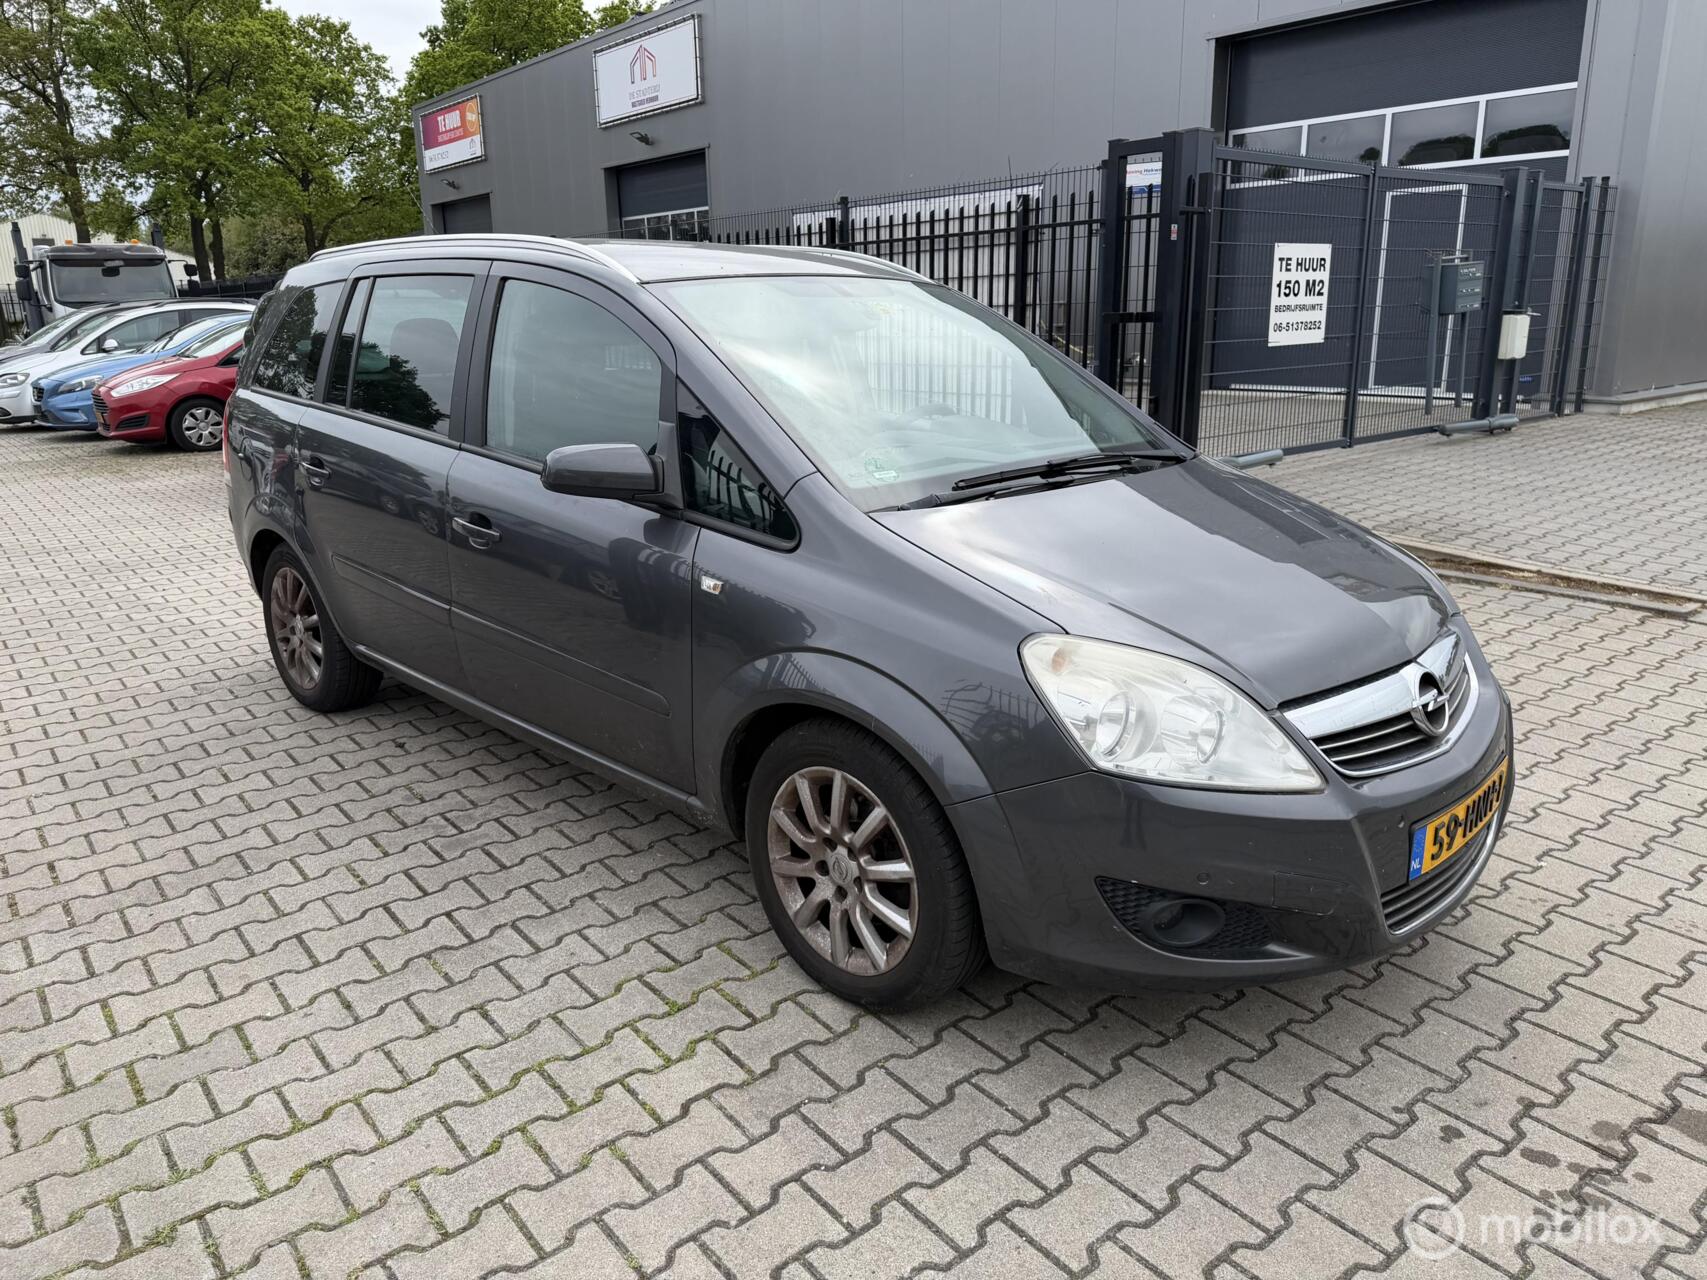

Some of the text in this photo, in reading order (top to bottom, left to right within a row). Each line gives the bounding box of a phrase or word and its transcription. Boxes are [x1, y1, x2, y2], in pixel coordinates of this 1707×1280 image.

[1278, 257, 1326, 272] TE HUUR
[1276, 279, 1325, 298] 150 M2
[1274, 304, 1323, 313] BEDRIJFSRUIMTE
[1273, 321, 1322, 333] 06-51378252
[1410, 857, 1421, 871] NL
